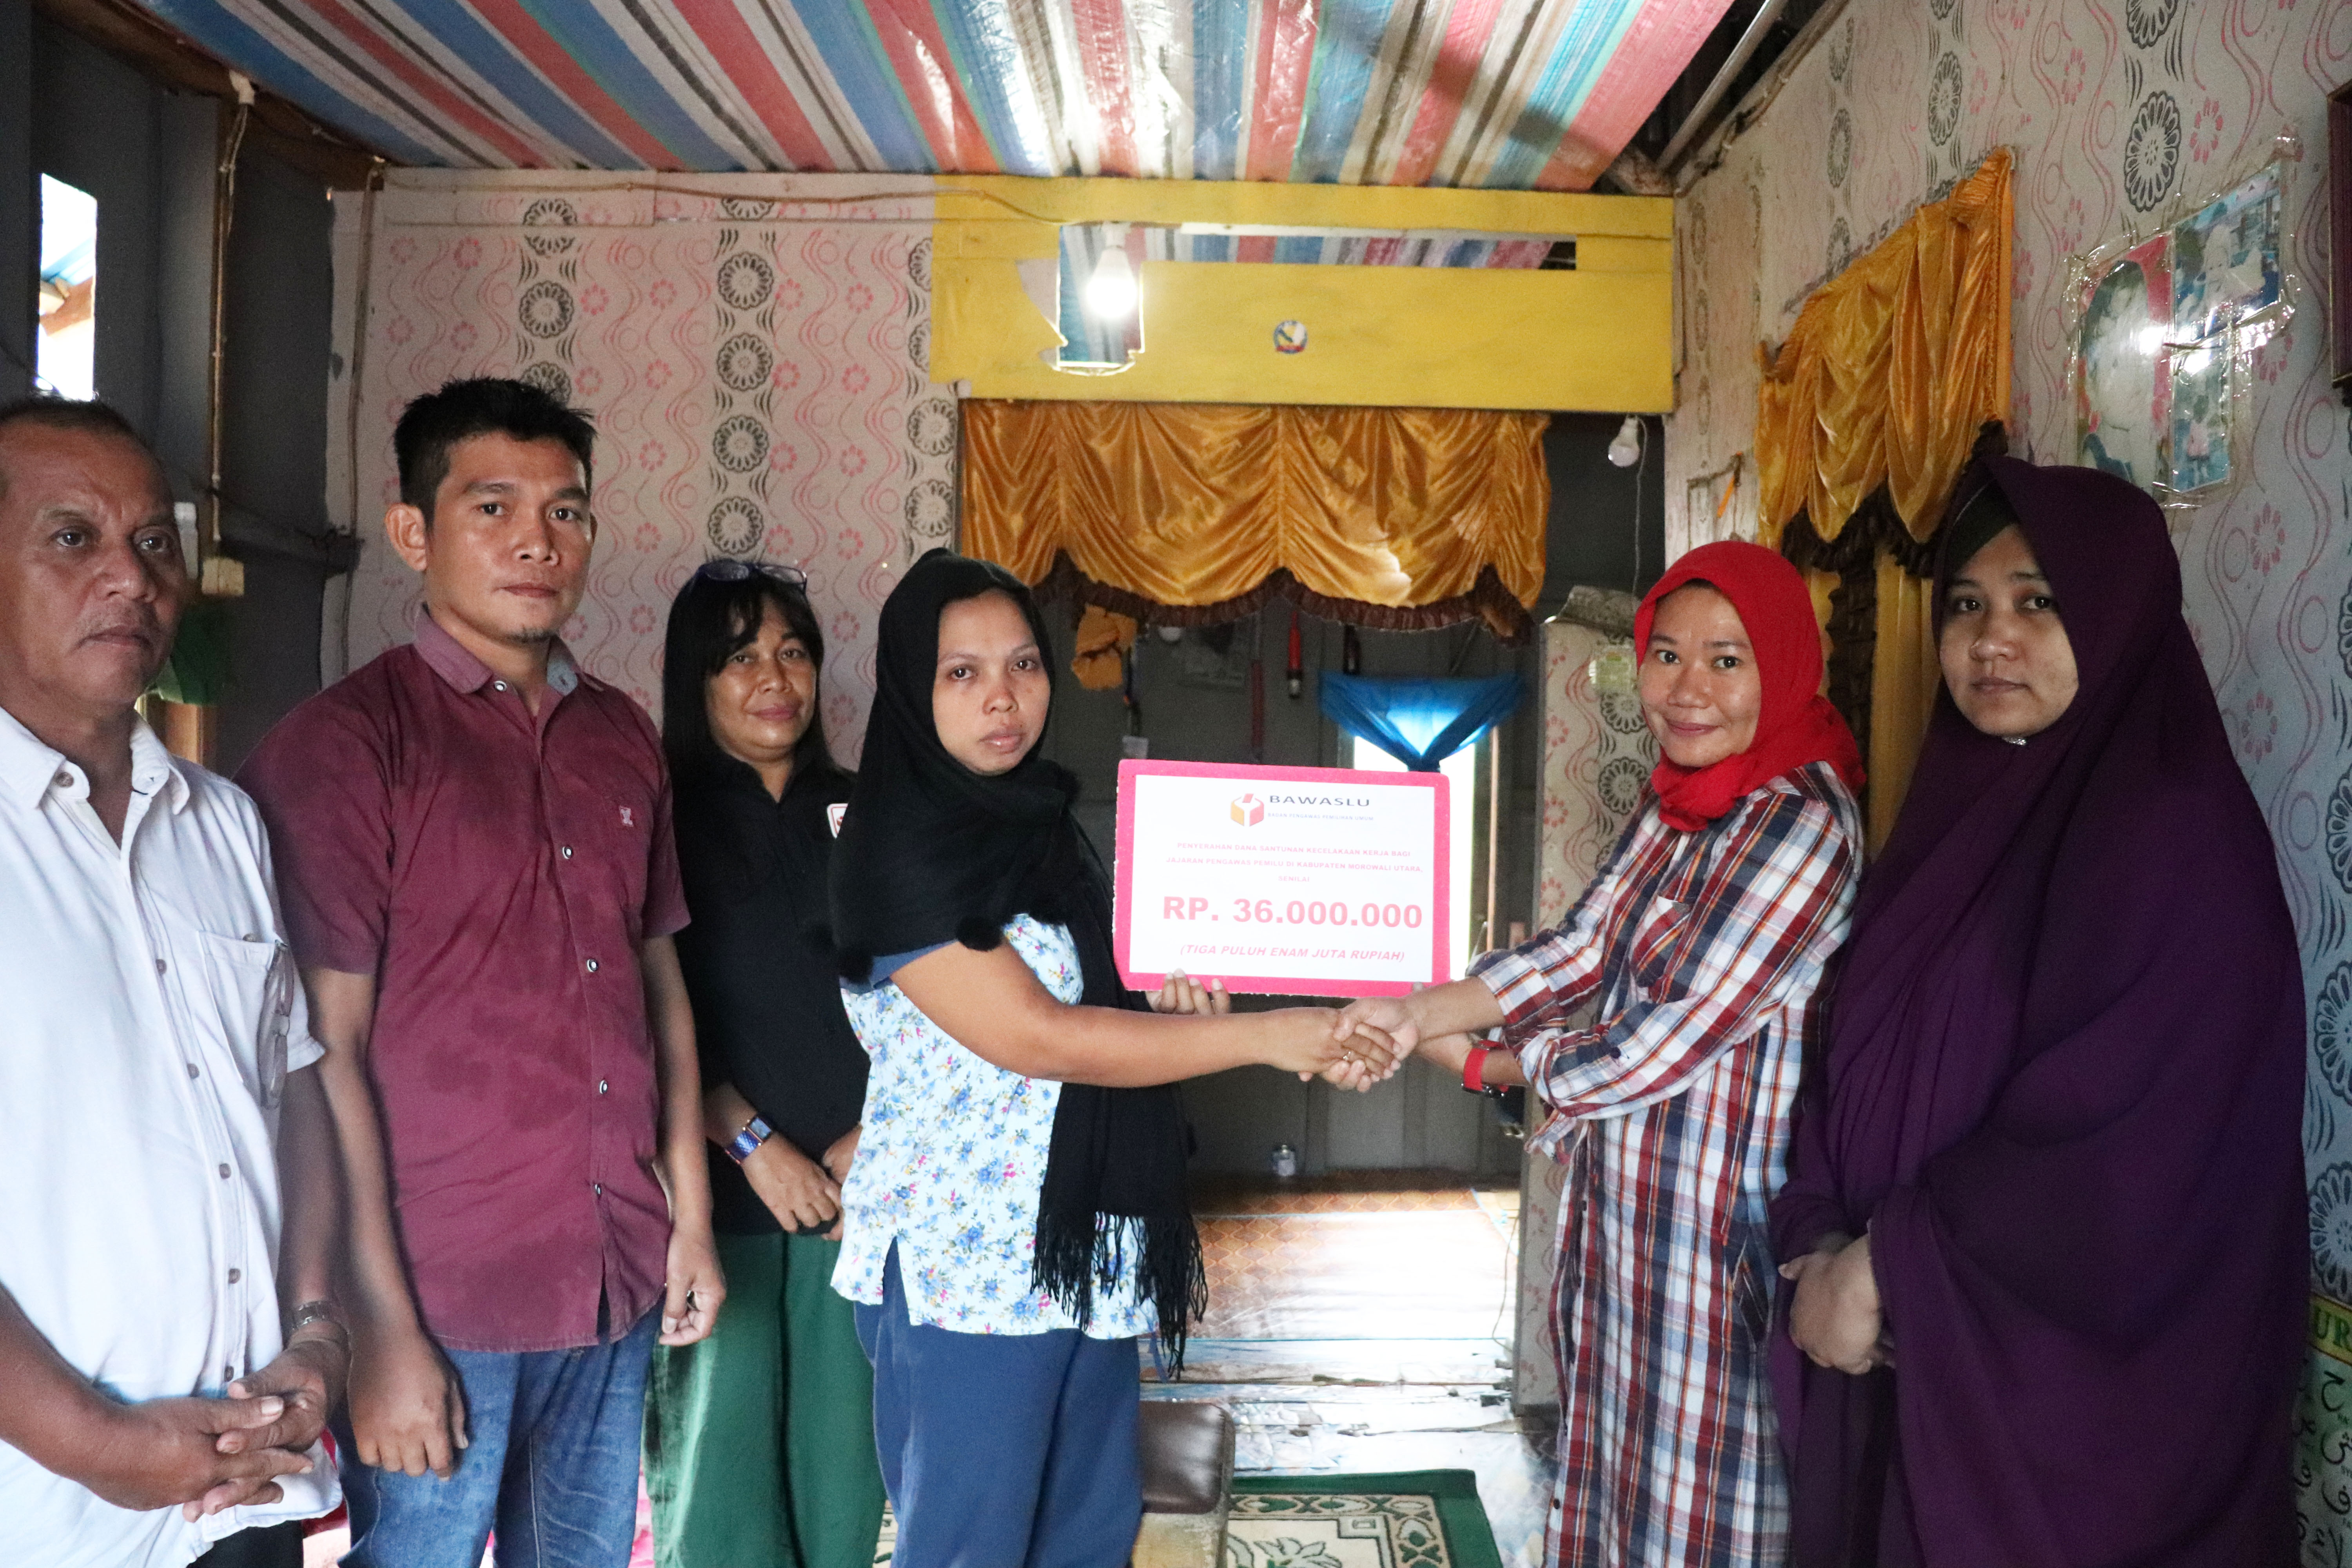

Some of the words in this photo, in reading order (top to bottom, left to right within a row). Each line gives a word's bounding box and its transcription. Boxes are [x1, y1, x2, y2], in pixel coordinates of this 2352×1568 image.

[1269, 795, 1370, 807] BAWASLU
[1163, 896, 1218, 921] RP.
[1232, 898, 1422, 928] 36.000.000
[1180, 945, 1216, 955] (TIGA
[1221, 946, 1267, 956] PULUH
[1270, 947, 1308, 957] ENAM
[1312, 949, 1345, 958] JUTA
[1350, 950, 1404, 962] RUPIAH)
